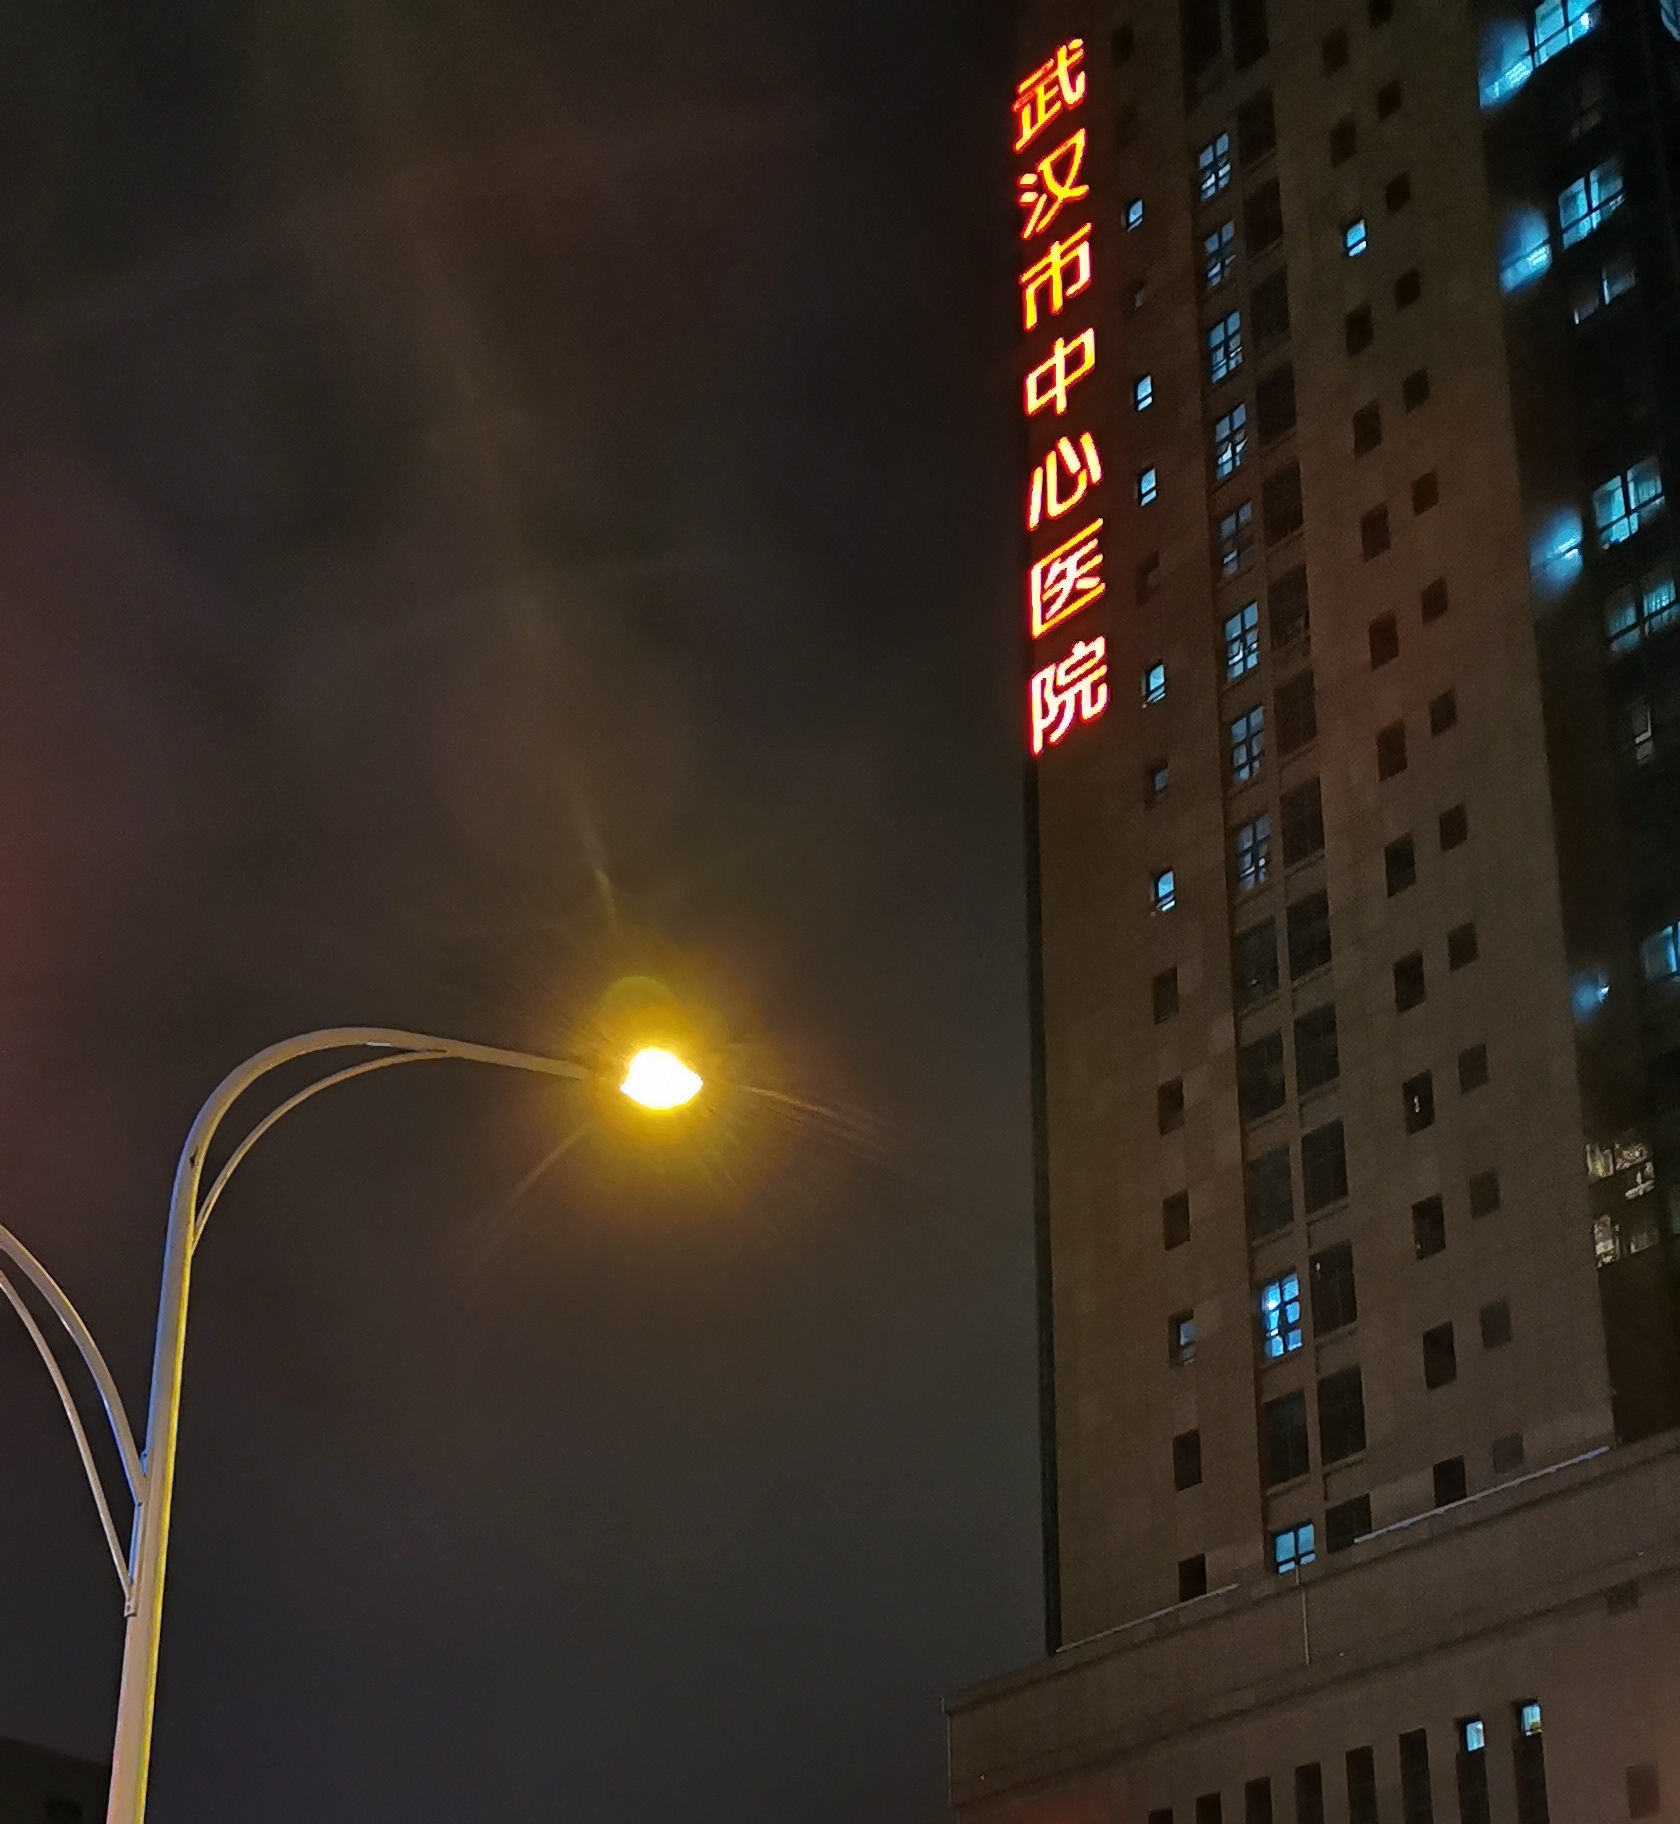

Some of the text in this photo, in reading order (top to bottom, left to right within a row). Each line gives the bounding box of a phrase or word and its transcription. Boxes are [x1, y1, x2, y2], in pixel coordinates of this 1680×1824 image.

[1013, 37, 1112, 757] 武汉市中心医院
